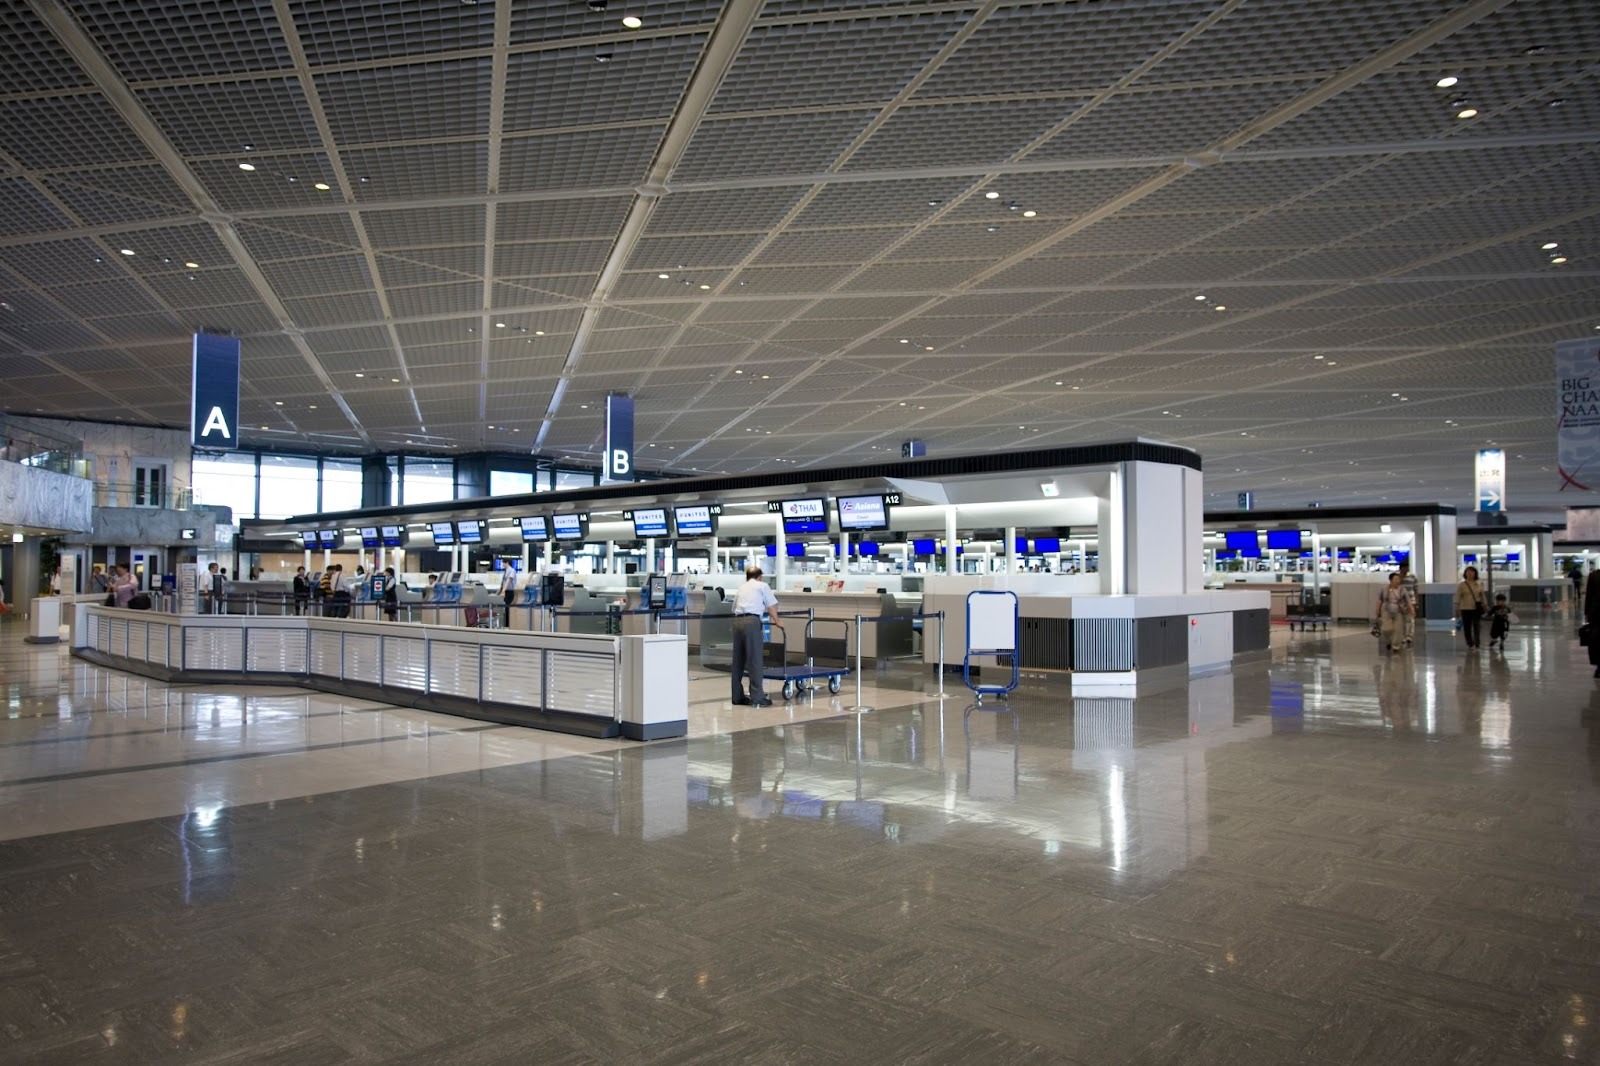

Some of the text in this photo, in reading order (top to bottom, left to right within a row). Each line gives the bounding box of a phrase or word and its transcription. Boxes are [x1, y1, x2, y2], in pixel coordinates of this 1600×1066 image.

[1562, 377, 1590, 391] BIG
[1562, 390, 1600, 404] CHA
[1563, 404, 1599, 417] NAA
[201, 406, 231, 439] A
[613, 449, 630, 474] B
[885, 495, 899, 504] A12
[710, 506, 721, 514] A10
[768, 503, 780, 511] A11
[798, 504, 817, 512] THAI
